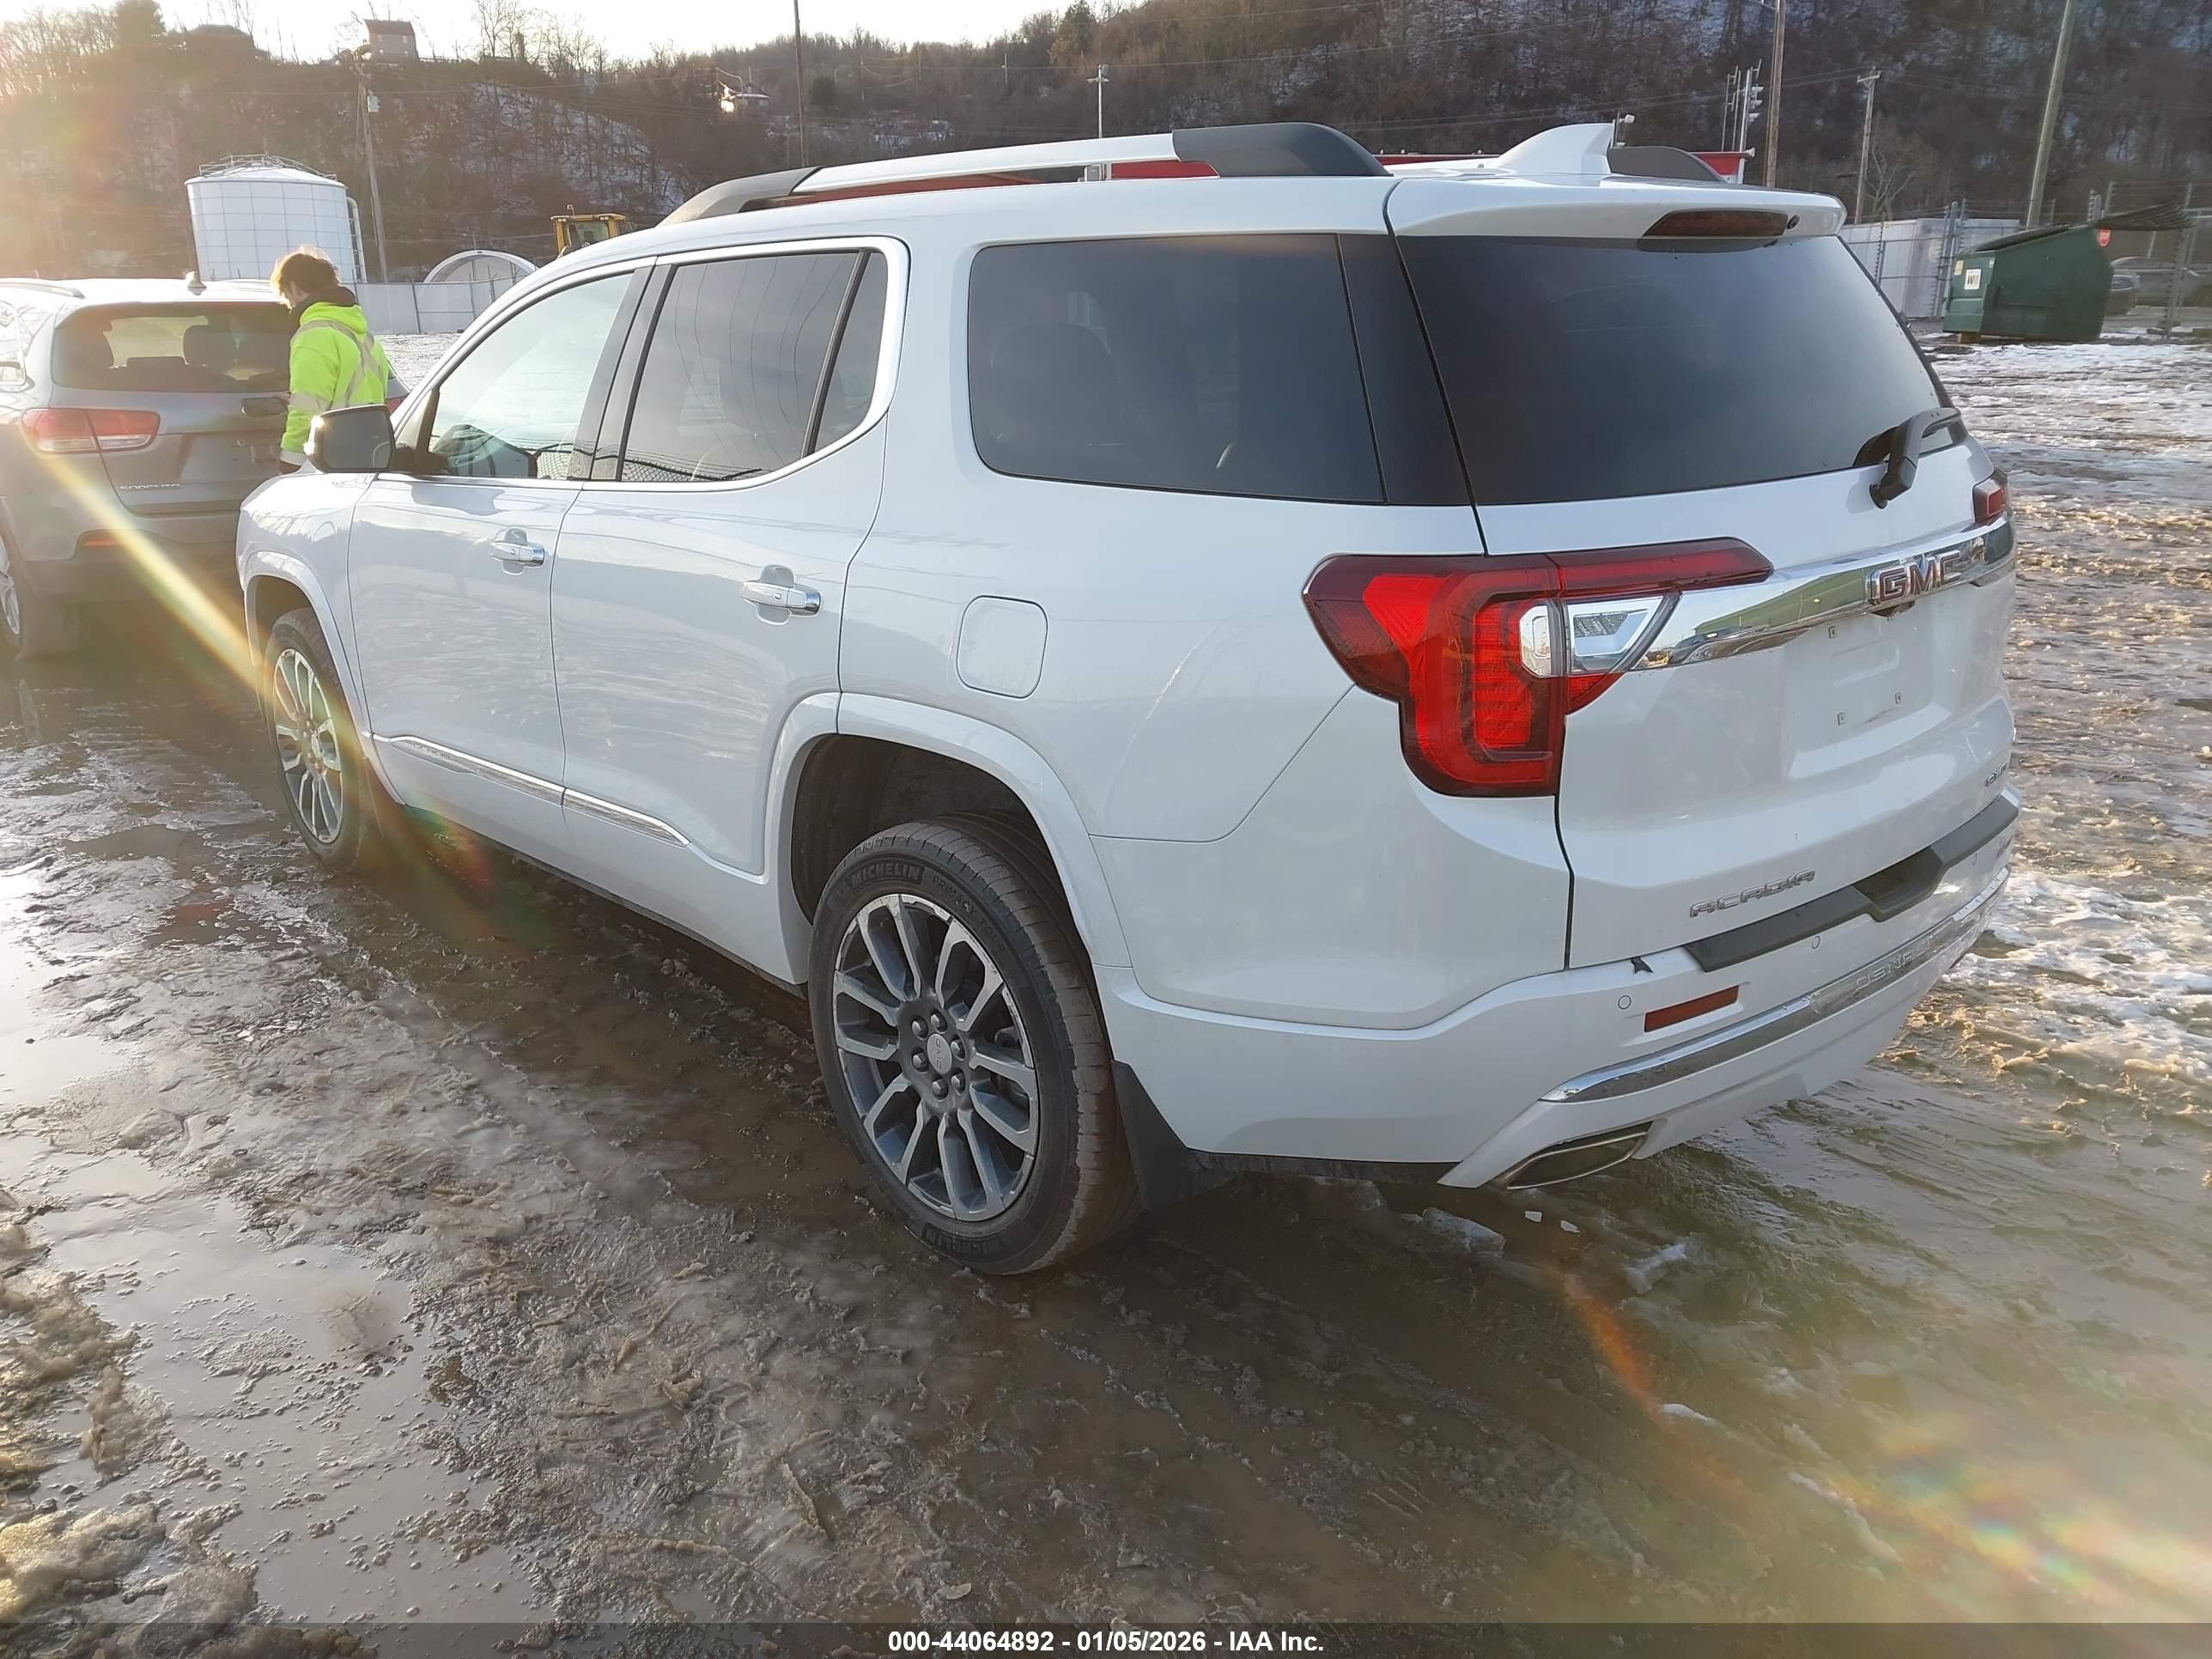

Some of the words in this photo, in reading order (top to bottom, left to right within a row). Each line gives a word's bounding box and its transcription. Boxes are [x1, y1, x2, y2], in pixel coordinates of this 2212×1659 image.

[1877, 550, 1962, 602] GMC
[851, 861, 921, 889] MICHELIN
[931, 875, 976, 915] PRIMACY
[1689, 867, 1815, 918] ACADIA
